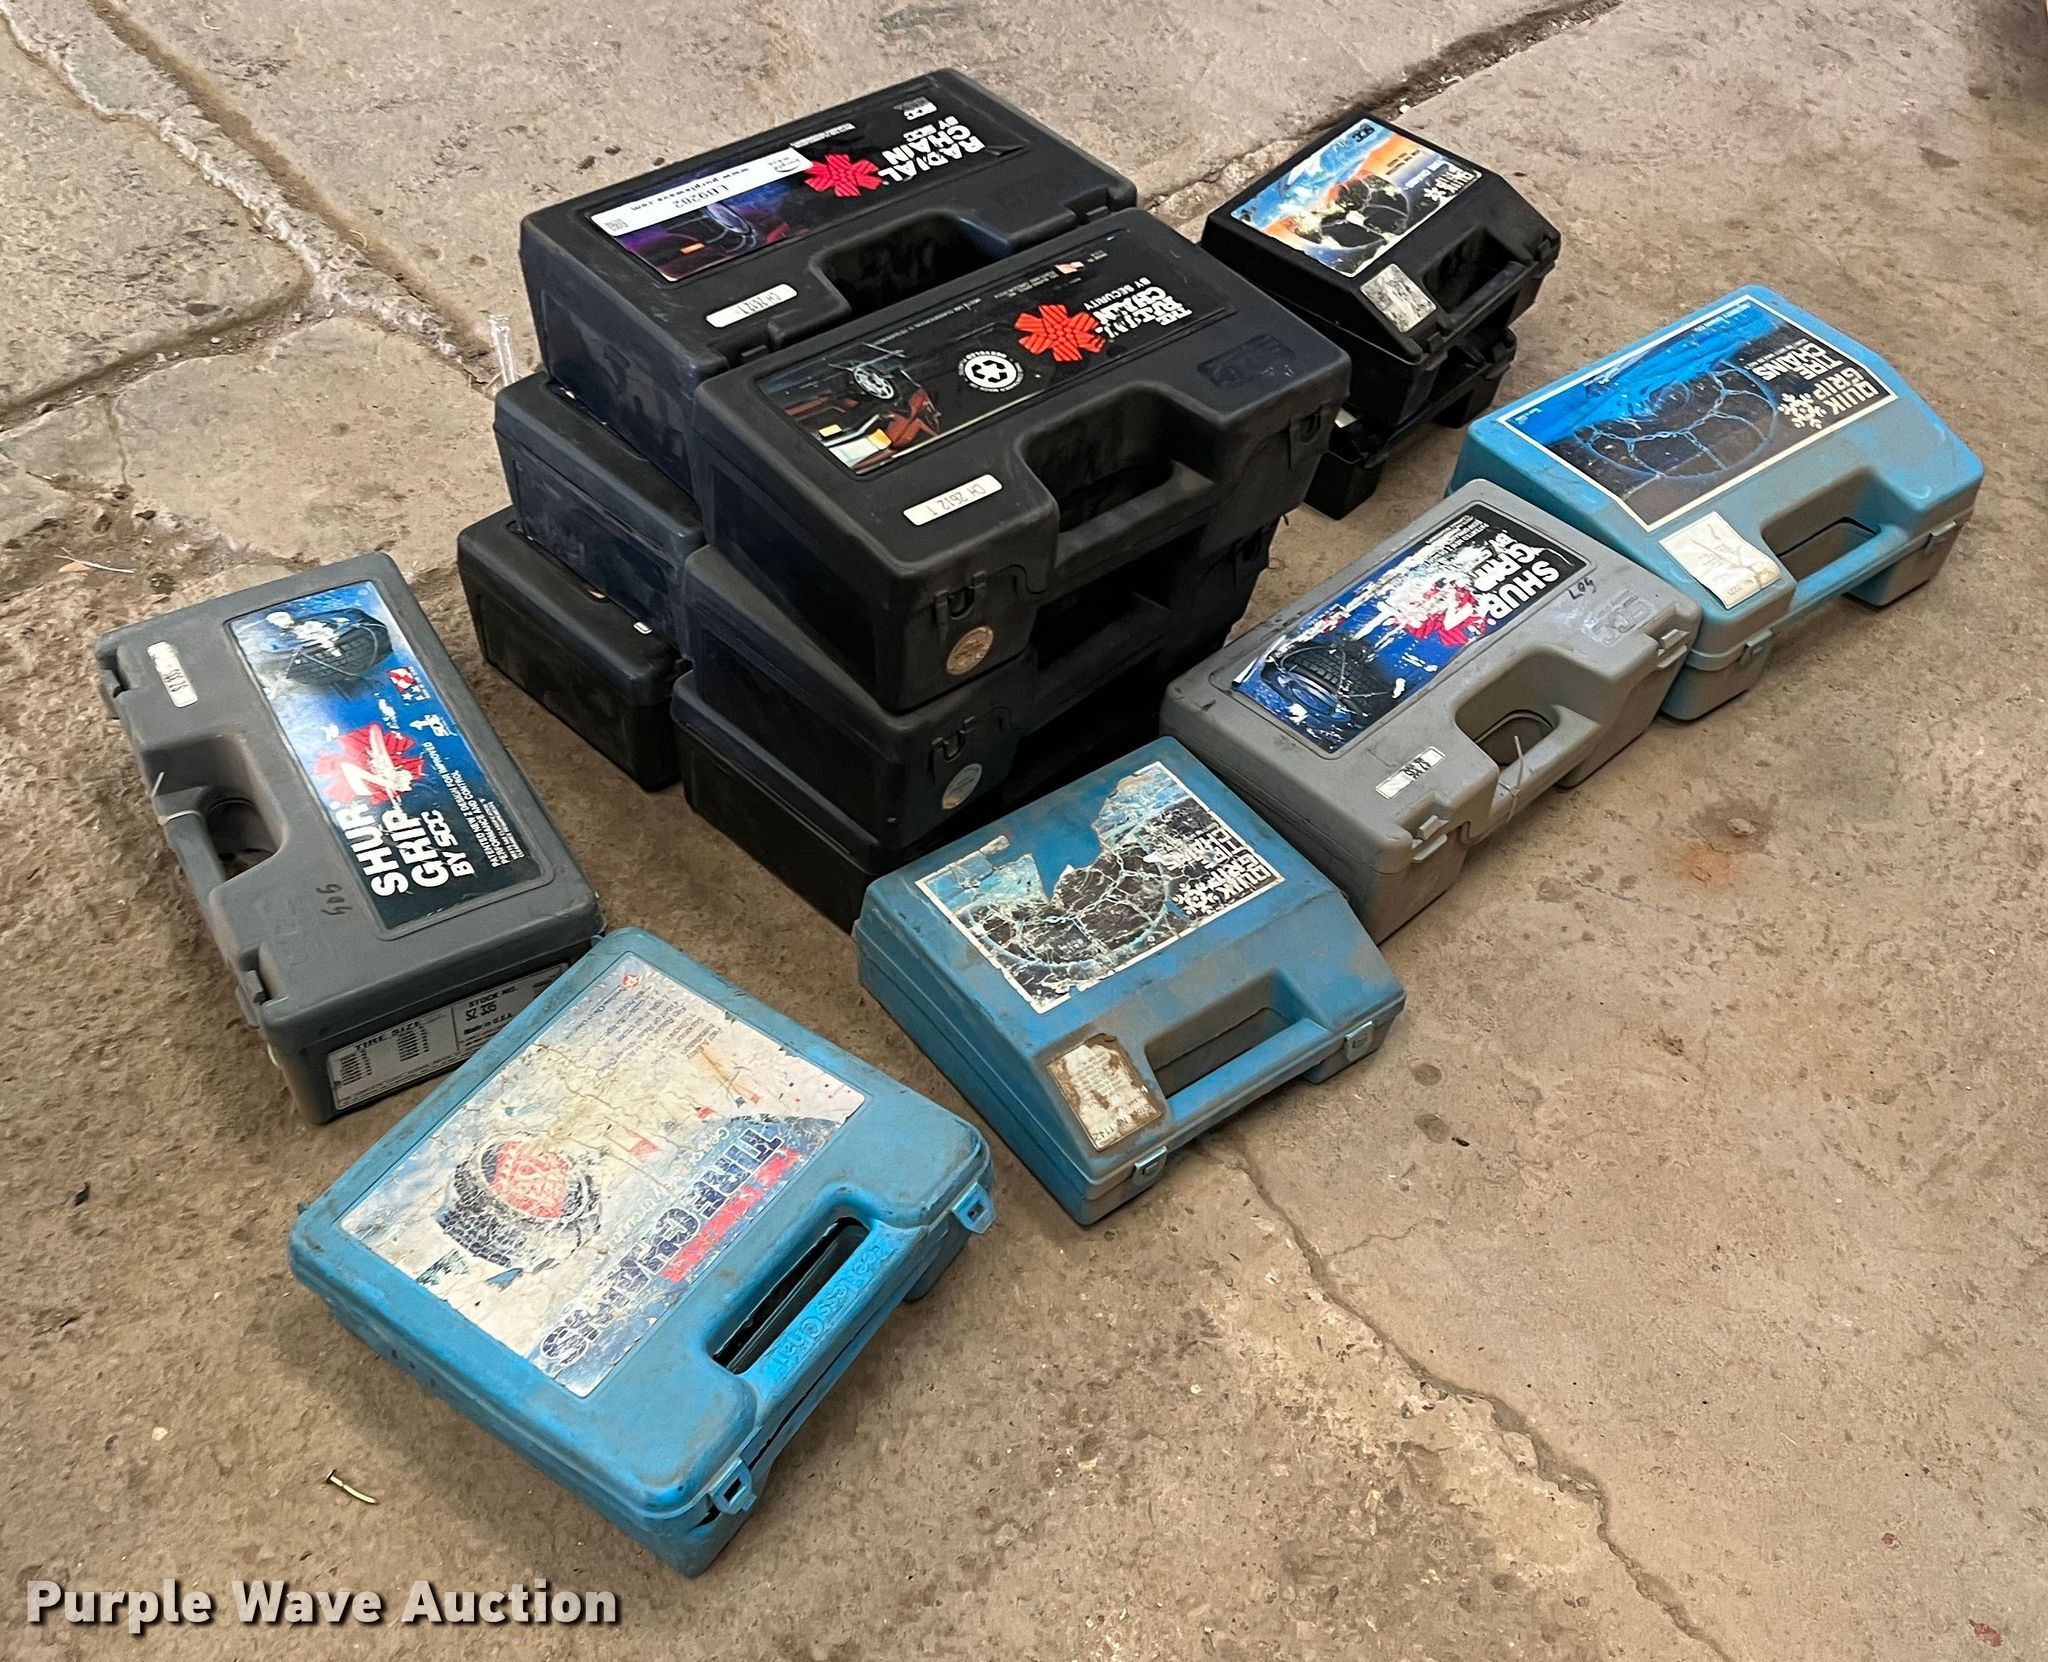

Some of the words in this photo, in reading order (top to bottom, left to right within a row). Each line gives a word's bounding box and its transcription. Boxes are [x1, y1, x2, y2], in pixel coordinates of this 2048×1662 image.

[878, 136, 986, 182] RADIAL
[881, 122, 972, 165] CHAIN
[1444, 171, 1474, 193] QUIK
[1082, 284, 1135, 310] SECURITY
[1133, 277, 1152, 289] BY
[1153, 306, 1193, 326] THE
[1752, 341, 1826, 381] CHAINS
[1792, 352, 1843, 380] TIRE
[1810, 366, 1864, 400] GRIP
[1822, 380, 1879, 415] QUIK
[936, 491, 968, 511] 2612
[422, 741, 448, 774] IMPROVED
[440, 773, 456, 787] FOR
[450, 770, 473, 800] CONTROL
[449, 787, 470, 812] DESIGN
[467, 800, 482, 814] AND
[420, 809, 458, 848] SCC
[466, 816, 482, 833] NEW
[476, 814, 510, 864] PERFORMANCE
[333, 802, 408, 896] SHUR
[380, 806, 449, 888] GRIP
[474, 832, 501, 867] PATENTED
[442, 850, 475, 877] BY
[1205, 853, 1258, 889] GRIP
[1215, 864, 1271, 900] QUIK
[465, 1007, 478, 1022] SZ
[480, 1000, 497, 1016] 335
[468, 992, 499, 1008] STOCK
[355, 1035, 384, 1051] TIRE
[391, 1020, 421, 1037] SIZE
[676, 1121, 786, 1221] TIRE
[530, 1202, 707, 1373] CHAINS
